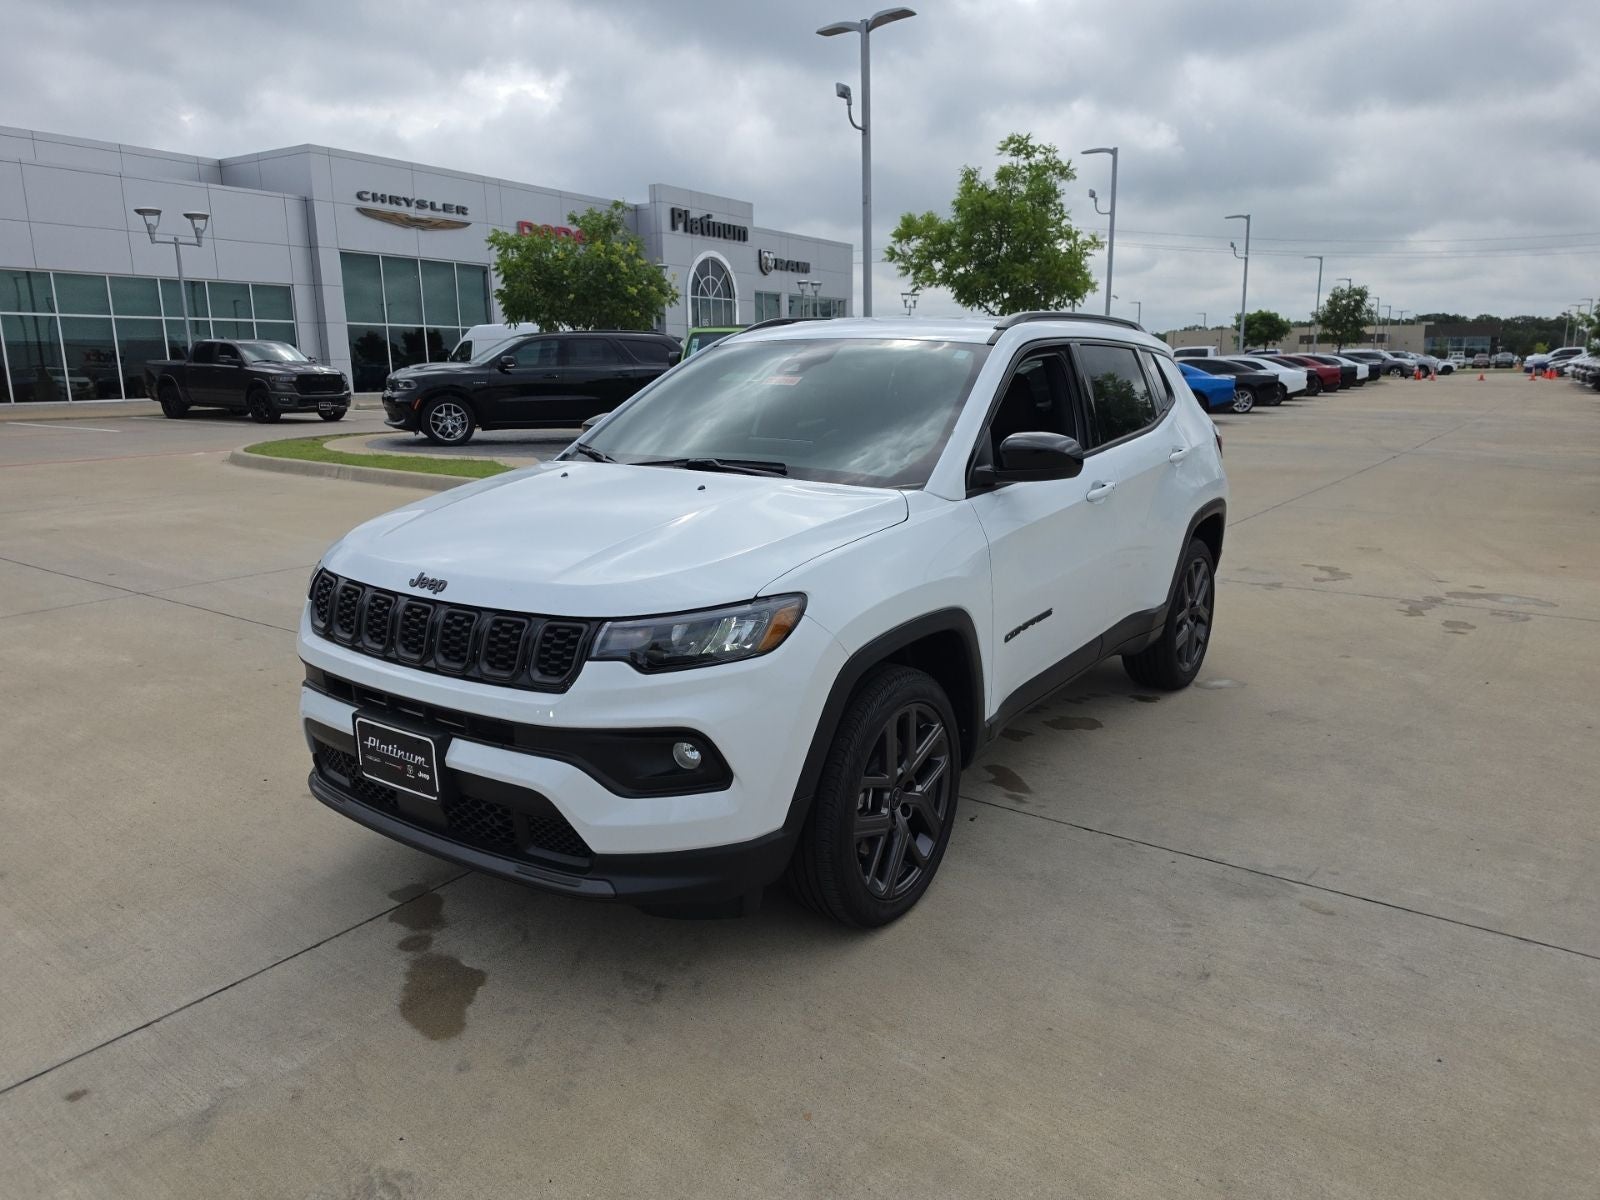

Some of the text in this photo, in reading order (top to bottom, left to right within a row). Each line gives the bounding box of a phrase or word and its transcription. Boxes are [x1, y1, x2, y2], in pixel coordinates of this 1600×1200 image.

[356, 190, 469, 216] CHRYSLER
[670, 207, 749, 242] Platinum
[773, 257, 811, 274] RAM
[409, 571, 448, 595] Jeep
[363, 736, 430, 768] Platinum
